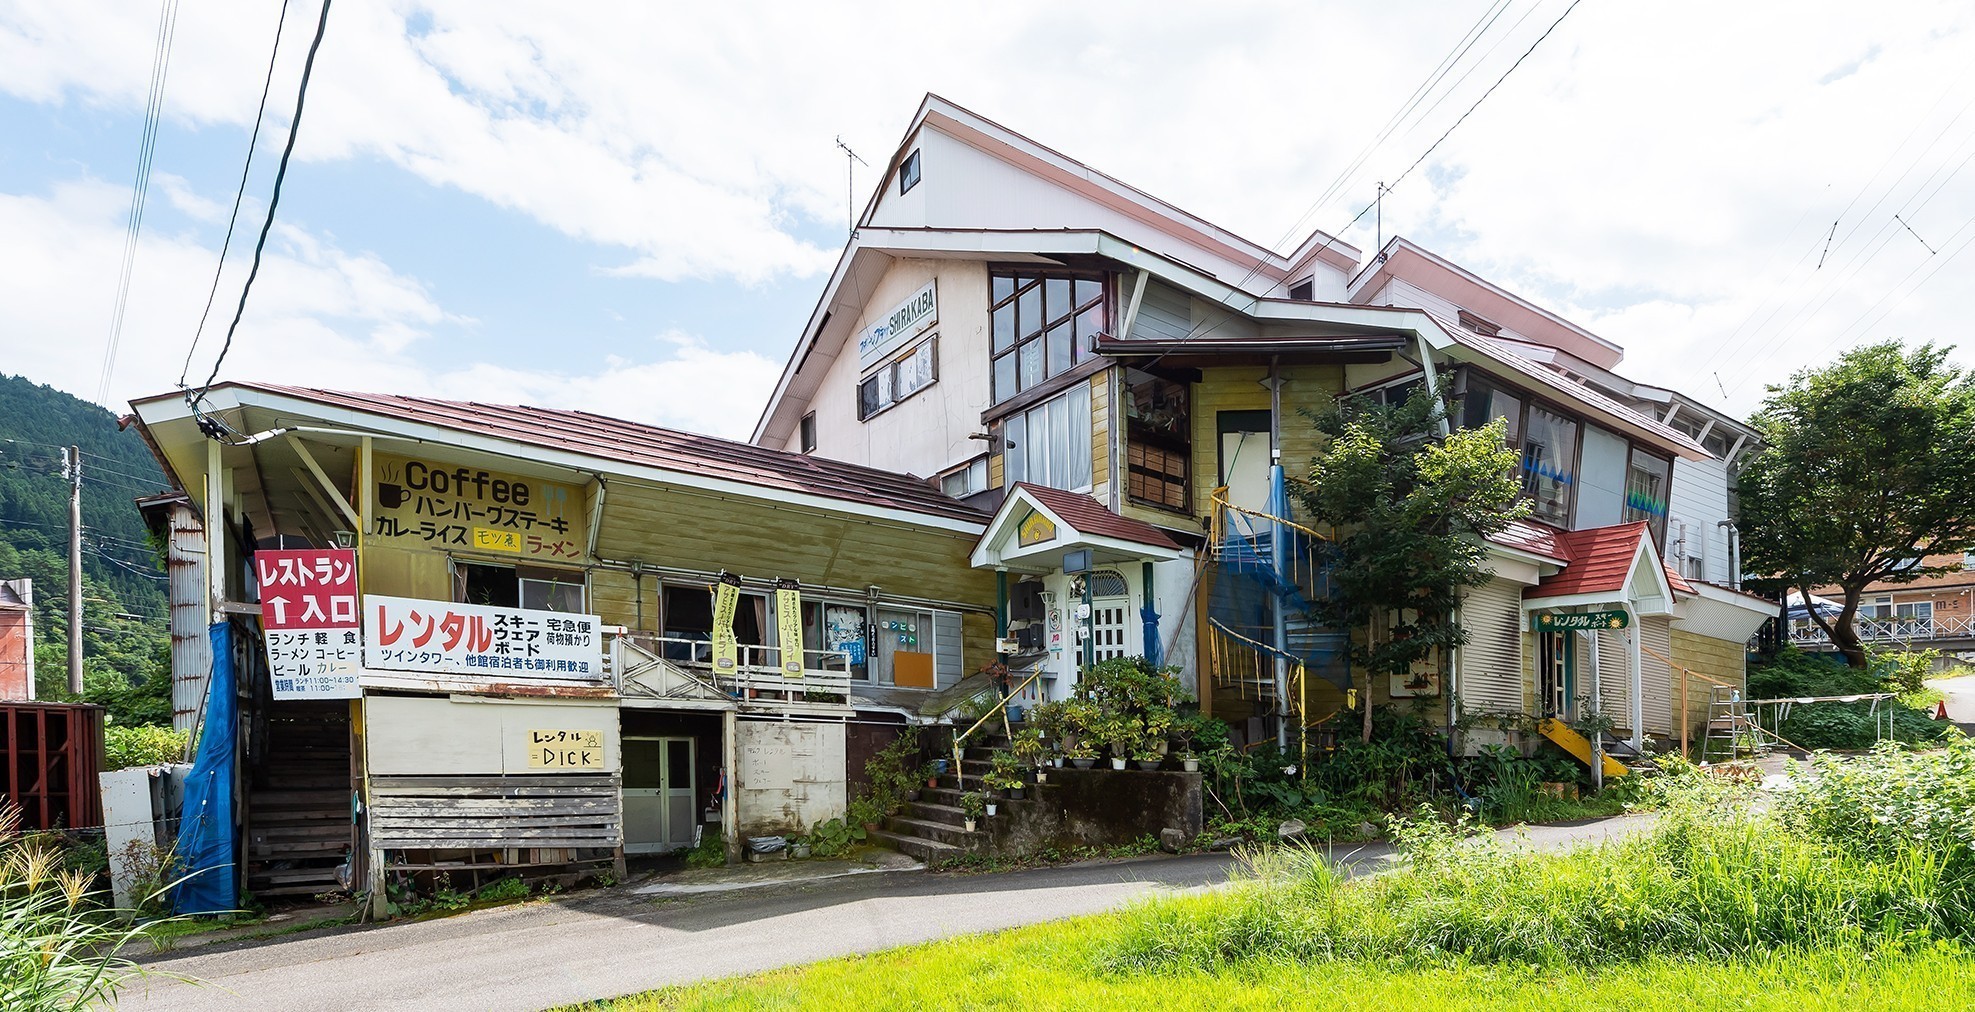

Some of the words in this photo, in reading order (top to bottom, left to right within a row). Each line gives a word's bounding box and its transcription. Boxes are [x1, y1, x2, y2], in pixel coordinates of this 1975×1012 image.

[889, 288, 934, 336] SHIRAKABA
[405, 461, 529, 506] Coffee
[415, 495, 569, 535] ハンバーグステーキ
[376, 516, 468, 546] カレーライス
[478, 530, 517, 548] モツ煮
[527, 535, 580, 558] ラーメン
[260, 557, 352, 587] レストラン
[301, 594, 356, 623] 入口
[379, 604, 493, 653] レンタル
[494, 613, 539, 628] スキー
[546, 618, 591, 634] 宅急便
[1553, 615, 1590, 627] レンタル
[269, 633, 309, 646] ランチ
[494, 627, 540, 642] ウェア
[546, 632, 591, 647] 荷物預かり
[271, 648, 309, 661] ラーメン
[316, 648, 355, 660] コーヒー
[494, 641, 540, 657] ボード
[274, 663, 310, 677] ビール
[317, 662, 347, 675] カレー
[533, 730, 582, 744] レンタル
